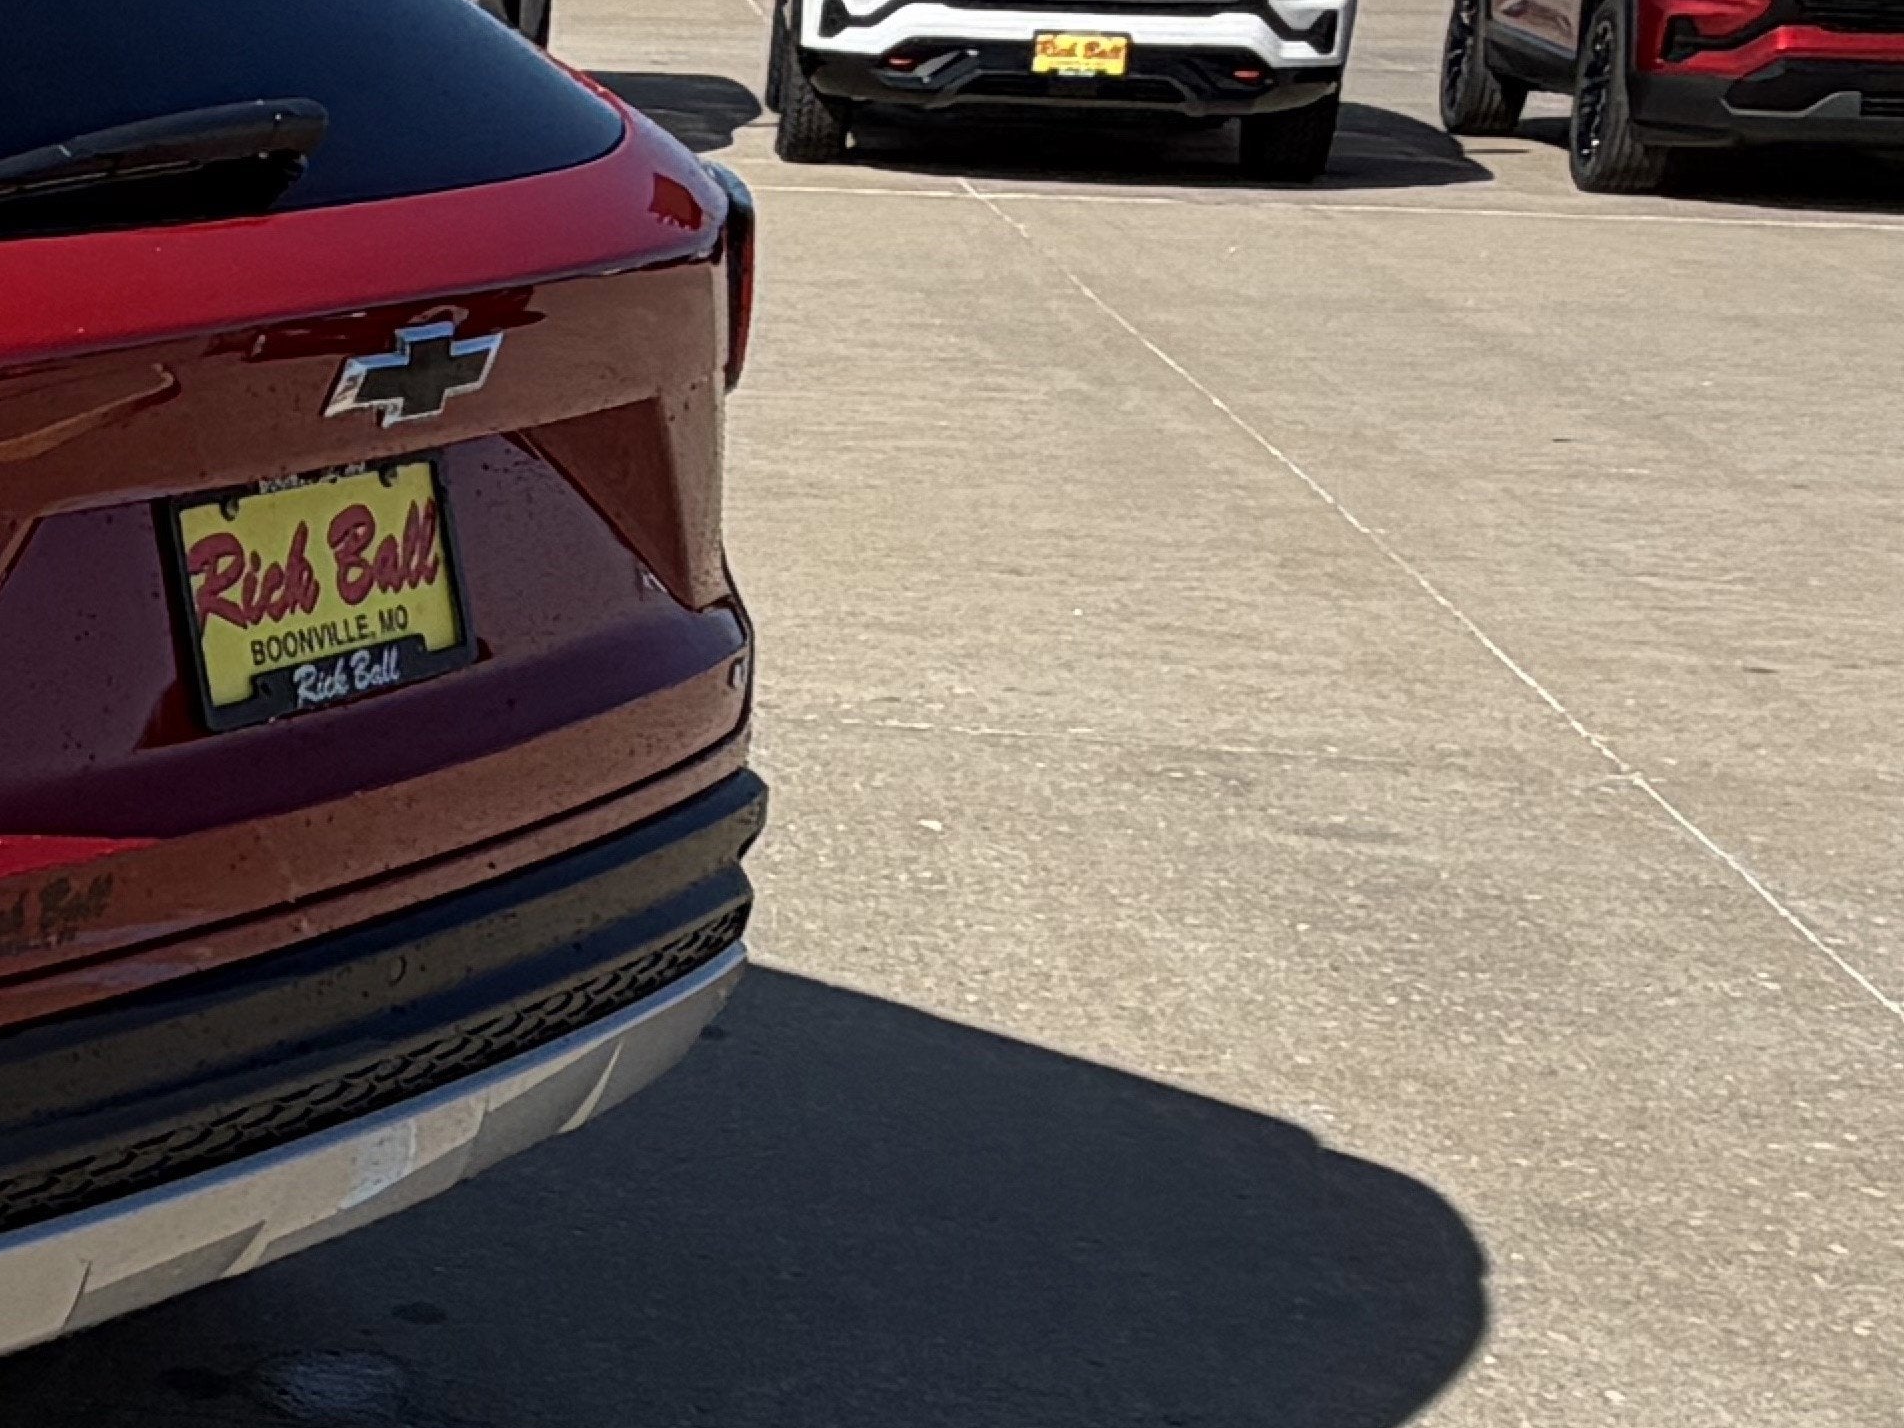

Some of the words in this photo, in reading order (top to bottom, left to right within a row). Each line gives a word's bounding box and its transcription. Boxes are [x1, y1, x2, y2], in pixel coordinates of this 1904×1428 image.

[188, 520, 320, 631] Rick
[327, 496, 439, 606] Ball
[250, 614, 376, 667] BOONVILLE,
[379, 604, 410, 640] MO
[293, 656, 349, 711] Rick
[348, 645, 400, 691] Ball
